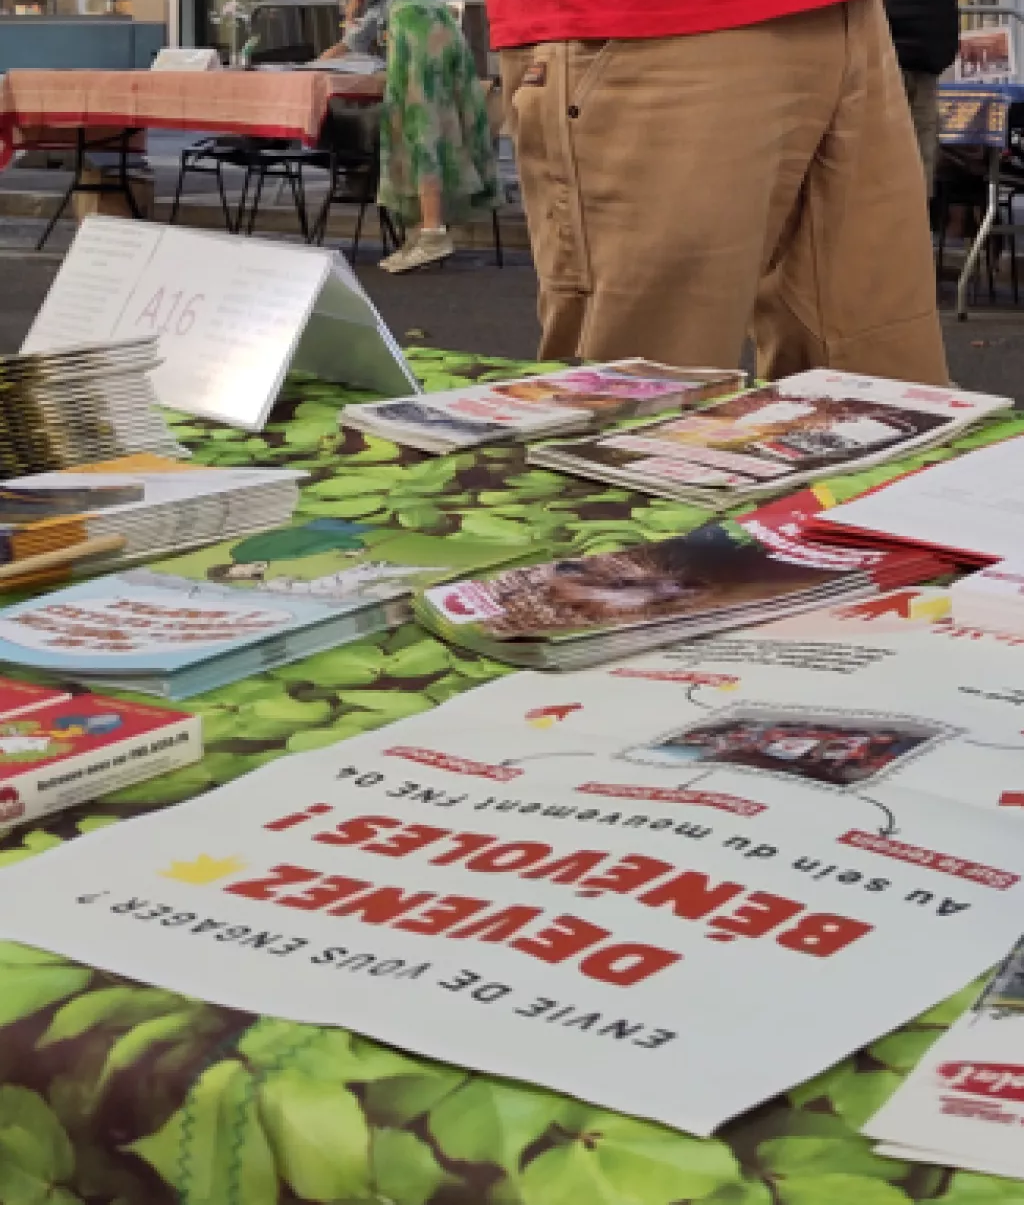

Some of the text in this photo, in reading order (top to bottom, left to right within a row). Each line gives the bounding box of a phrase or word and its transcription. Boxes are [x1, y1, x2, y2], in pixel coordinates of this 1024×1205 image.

[134, 285, 206, 336] A16
[389, 781, 470, 807] FNE
[474, 796, 711, 839] mouvement
[724, 836, 777, 857] du
[314, 815, 873, 957] BÉNÉVOLES
[793, 856, 890, 893] sein
[904, 890, 971, 917] Au
[110, 897, 309, 956] ENGAGER
[223, 865, 681, 986] DEVENEZ
[311, 947, 424, 979] VOUS
[439, 970, 512, 1002] DE
[515, 998, 676, 1049] ENVIE
